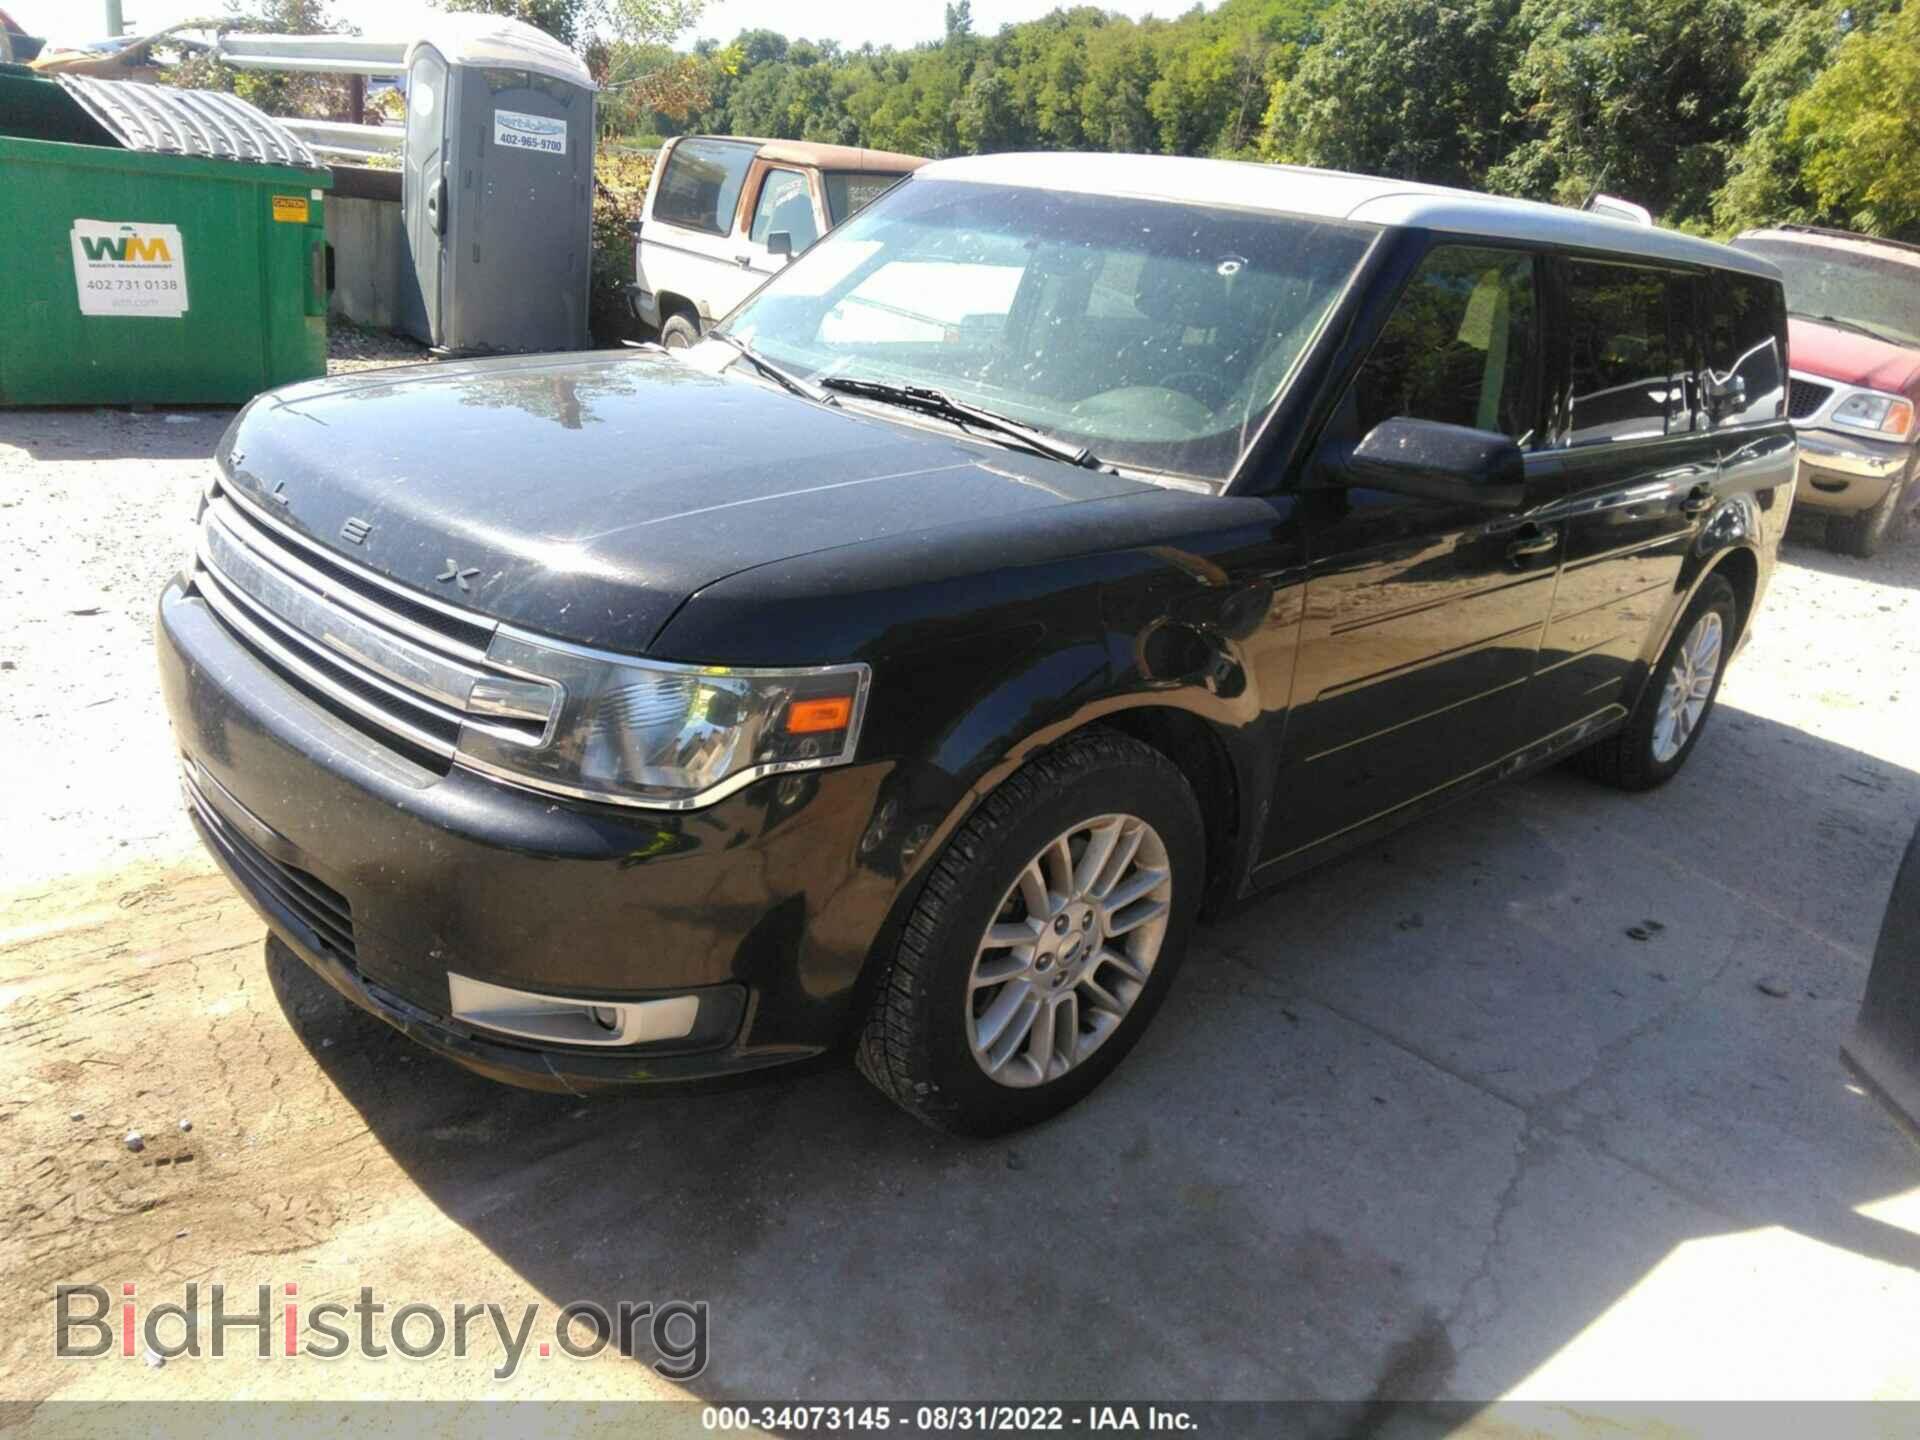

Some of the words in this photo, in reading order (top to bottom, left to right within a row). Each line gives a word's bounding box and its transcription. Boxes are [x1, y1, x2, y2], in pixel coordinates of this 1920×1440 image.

[501, 133, 561, 151] 402-965-9700
[80, 236, 172, 262] WM
[87, 280, 112, 290] 402
[117, 280, 139, 290] 731
[144, 280, 177, 290] 0138
